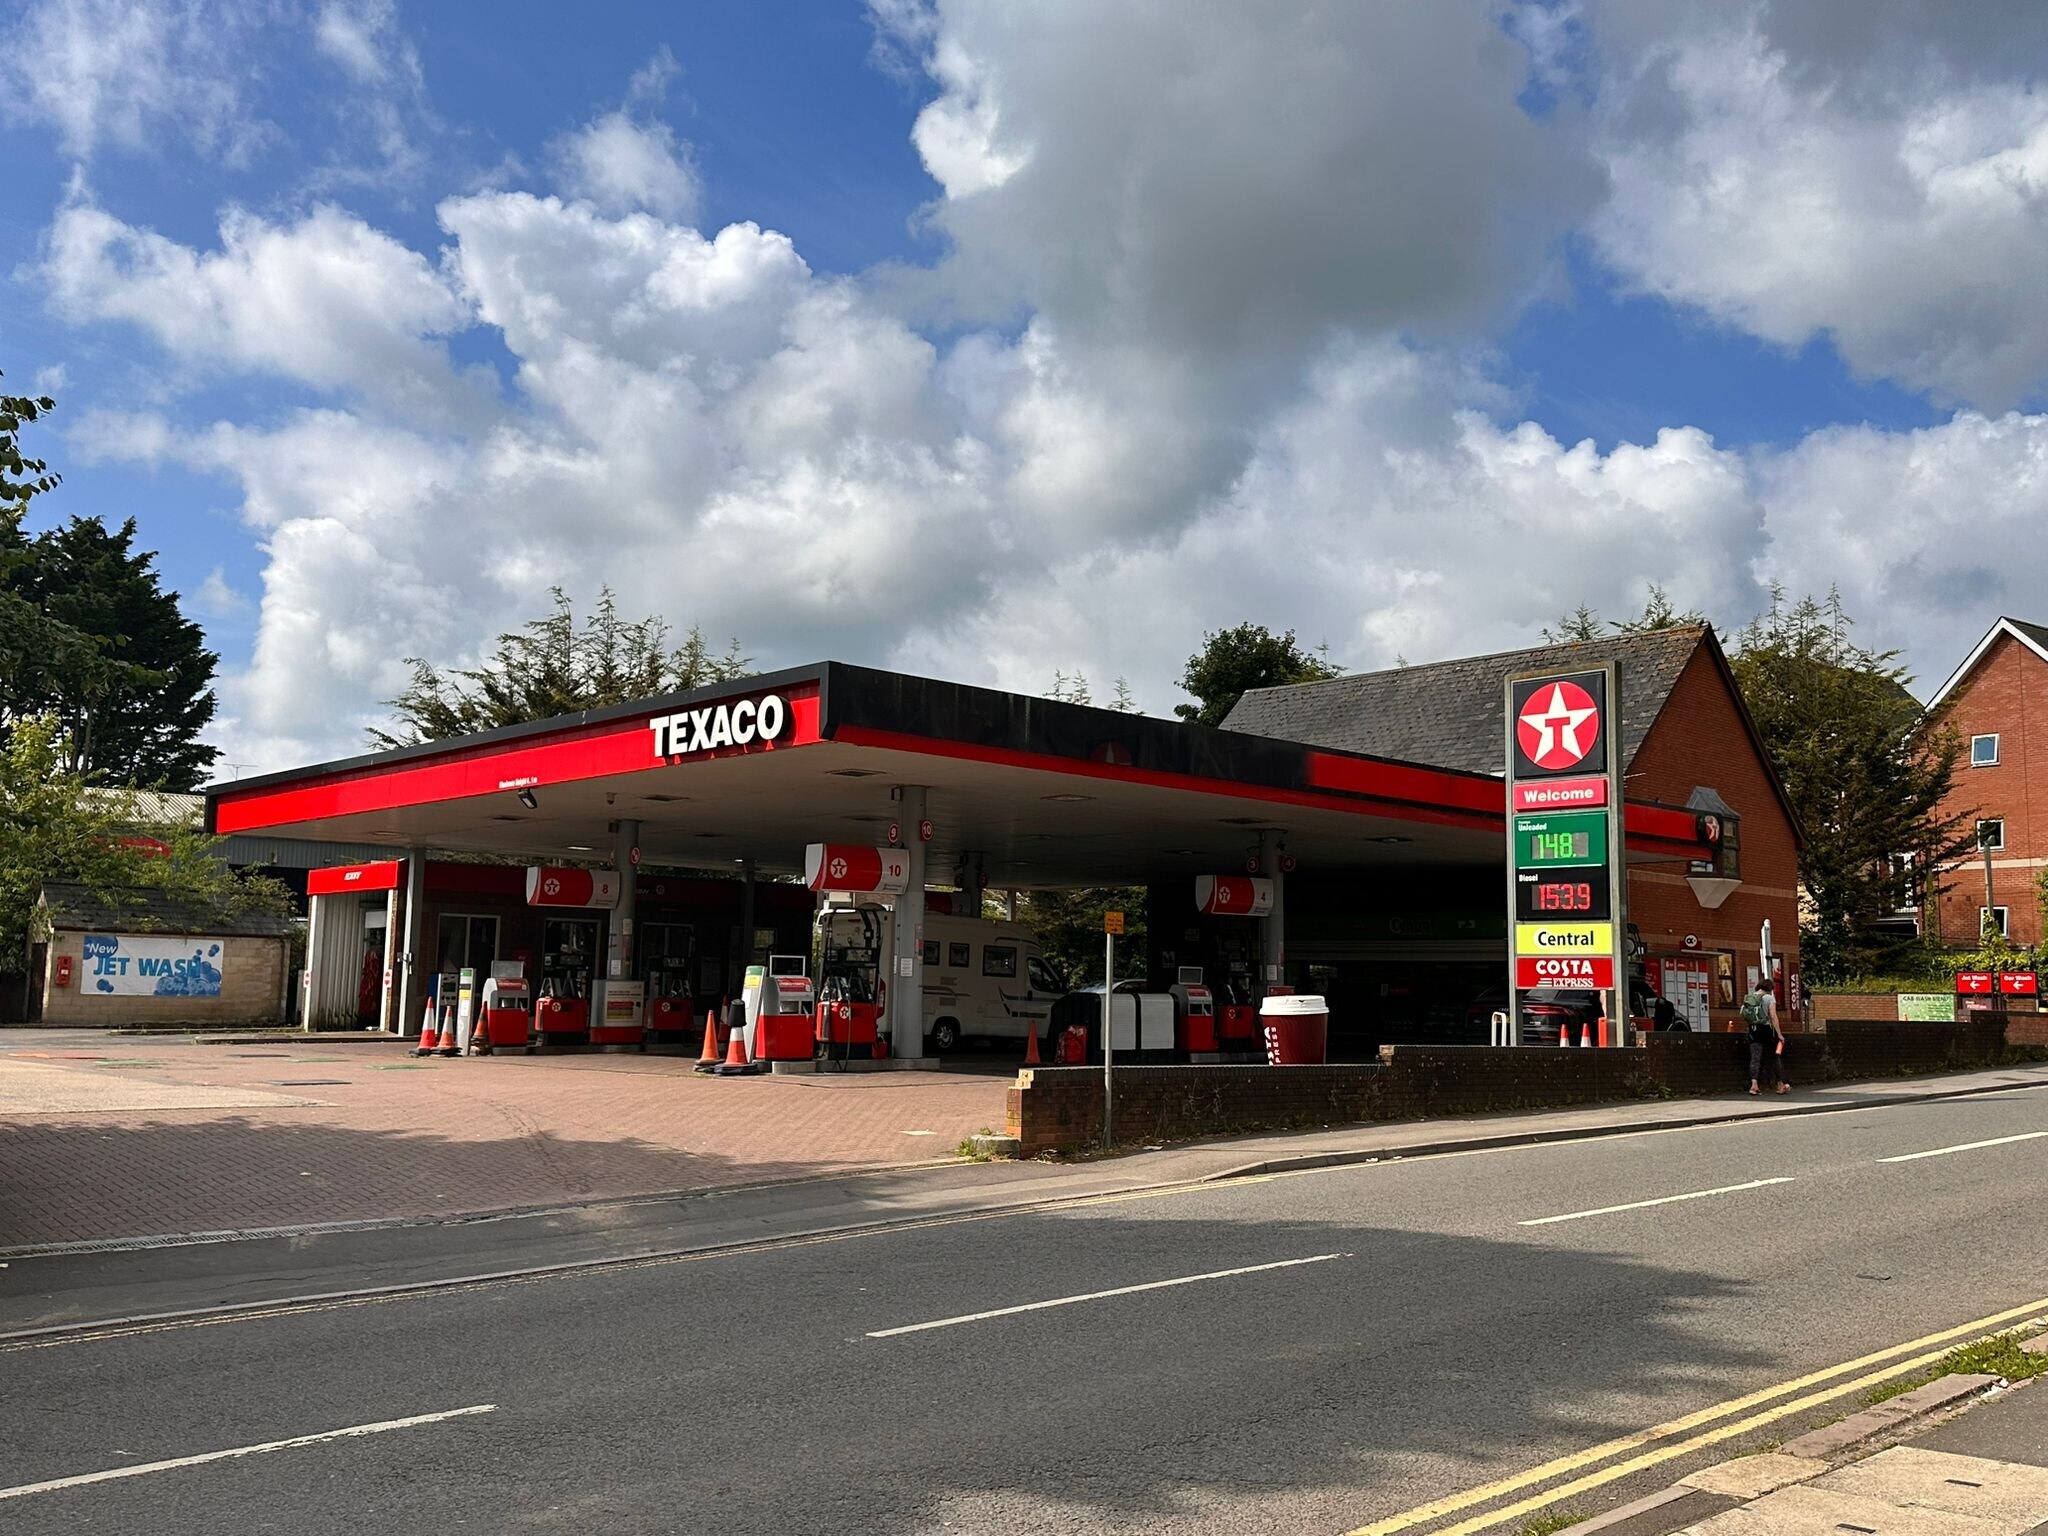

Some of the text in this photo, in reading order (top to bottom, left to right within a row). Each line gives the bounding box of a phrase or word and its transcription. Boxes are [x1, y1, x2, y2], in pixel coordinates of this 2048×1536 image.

[650, 695, 783, 757] TEXACO
[1524, 789, 1594, 803] Welcome
[923, 826, 931, 835] 10
[1518, 823, 1547, 832] Unleaded
[888, 865, 901, 876] 10
[1518, 874, 1538, 882] Diesel
[602, 884, 608, 894] 8
[1539, 884, 1590, 910] 153.9
[1538, 930, 1594, 946] Central
[89, 943, 117, 954] New
[93, 957, 201, 977] JET WASH
[1535, 960, 1594, 976] COSTA
[1553, 978, 1594, 988] EXPRESS
